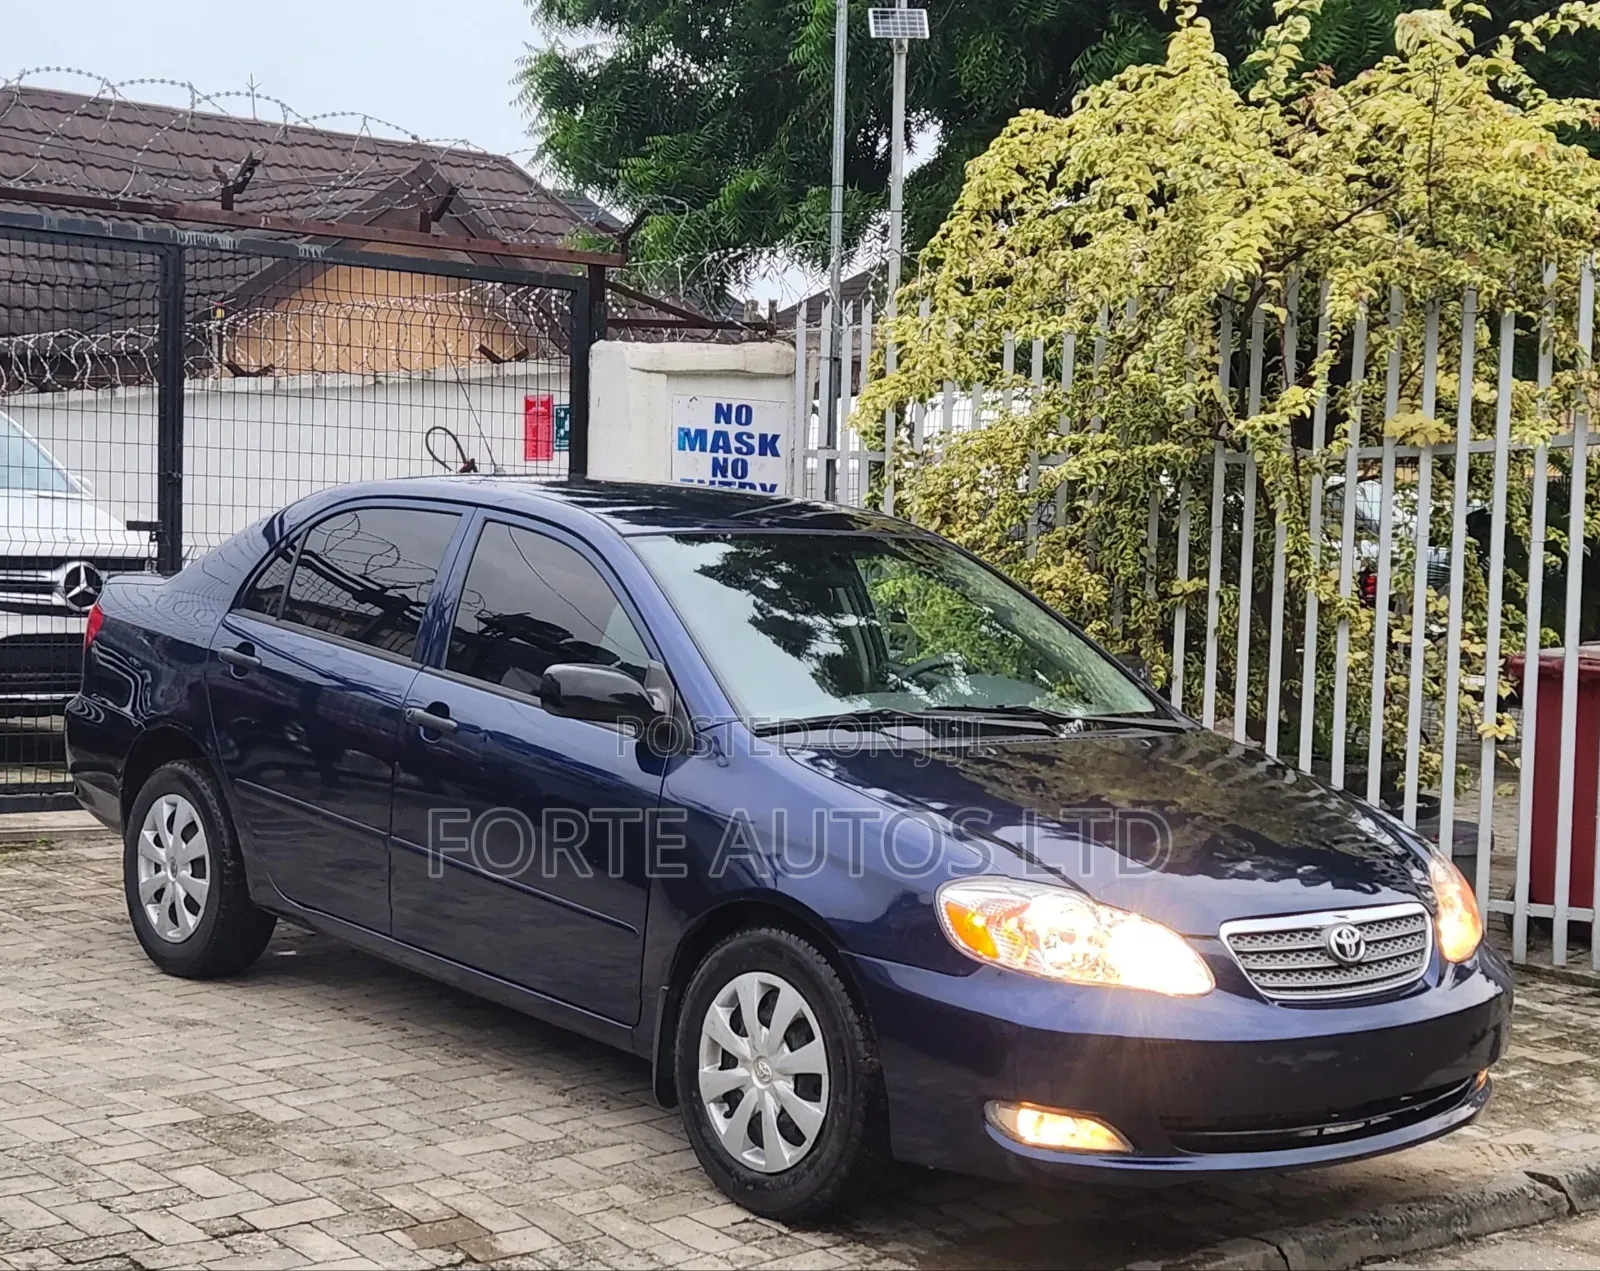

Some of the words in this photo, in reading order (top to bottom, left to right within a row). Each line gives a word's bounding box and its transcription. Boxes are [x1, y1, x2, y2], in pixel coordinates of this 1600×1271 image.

[714, 402, 753, 426] NO
[677, 426, 781, 458] MASK
[711, 456, 749, 480] NO
